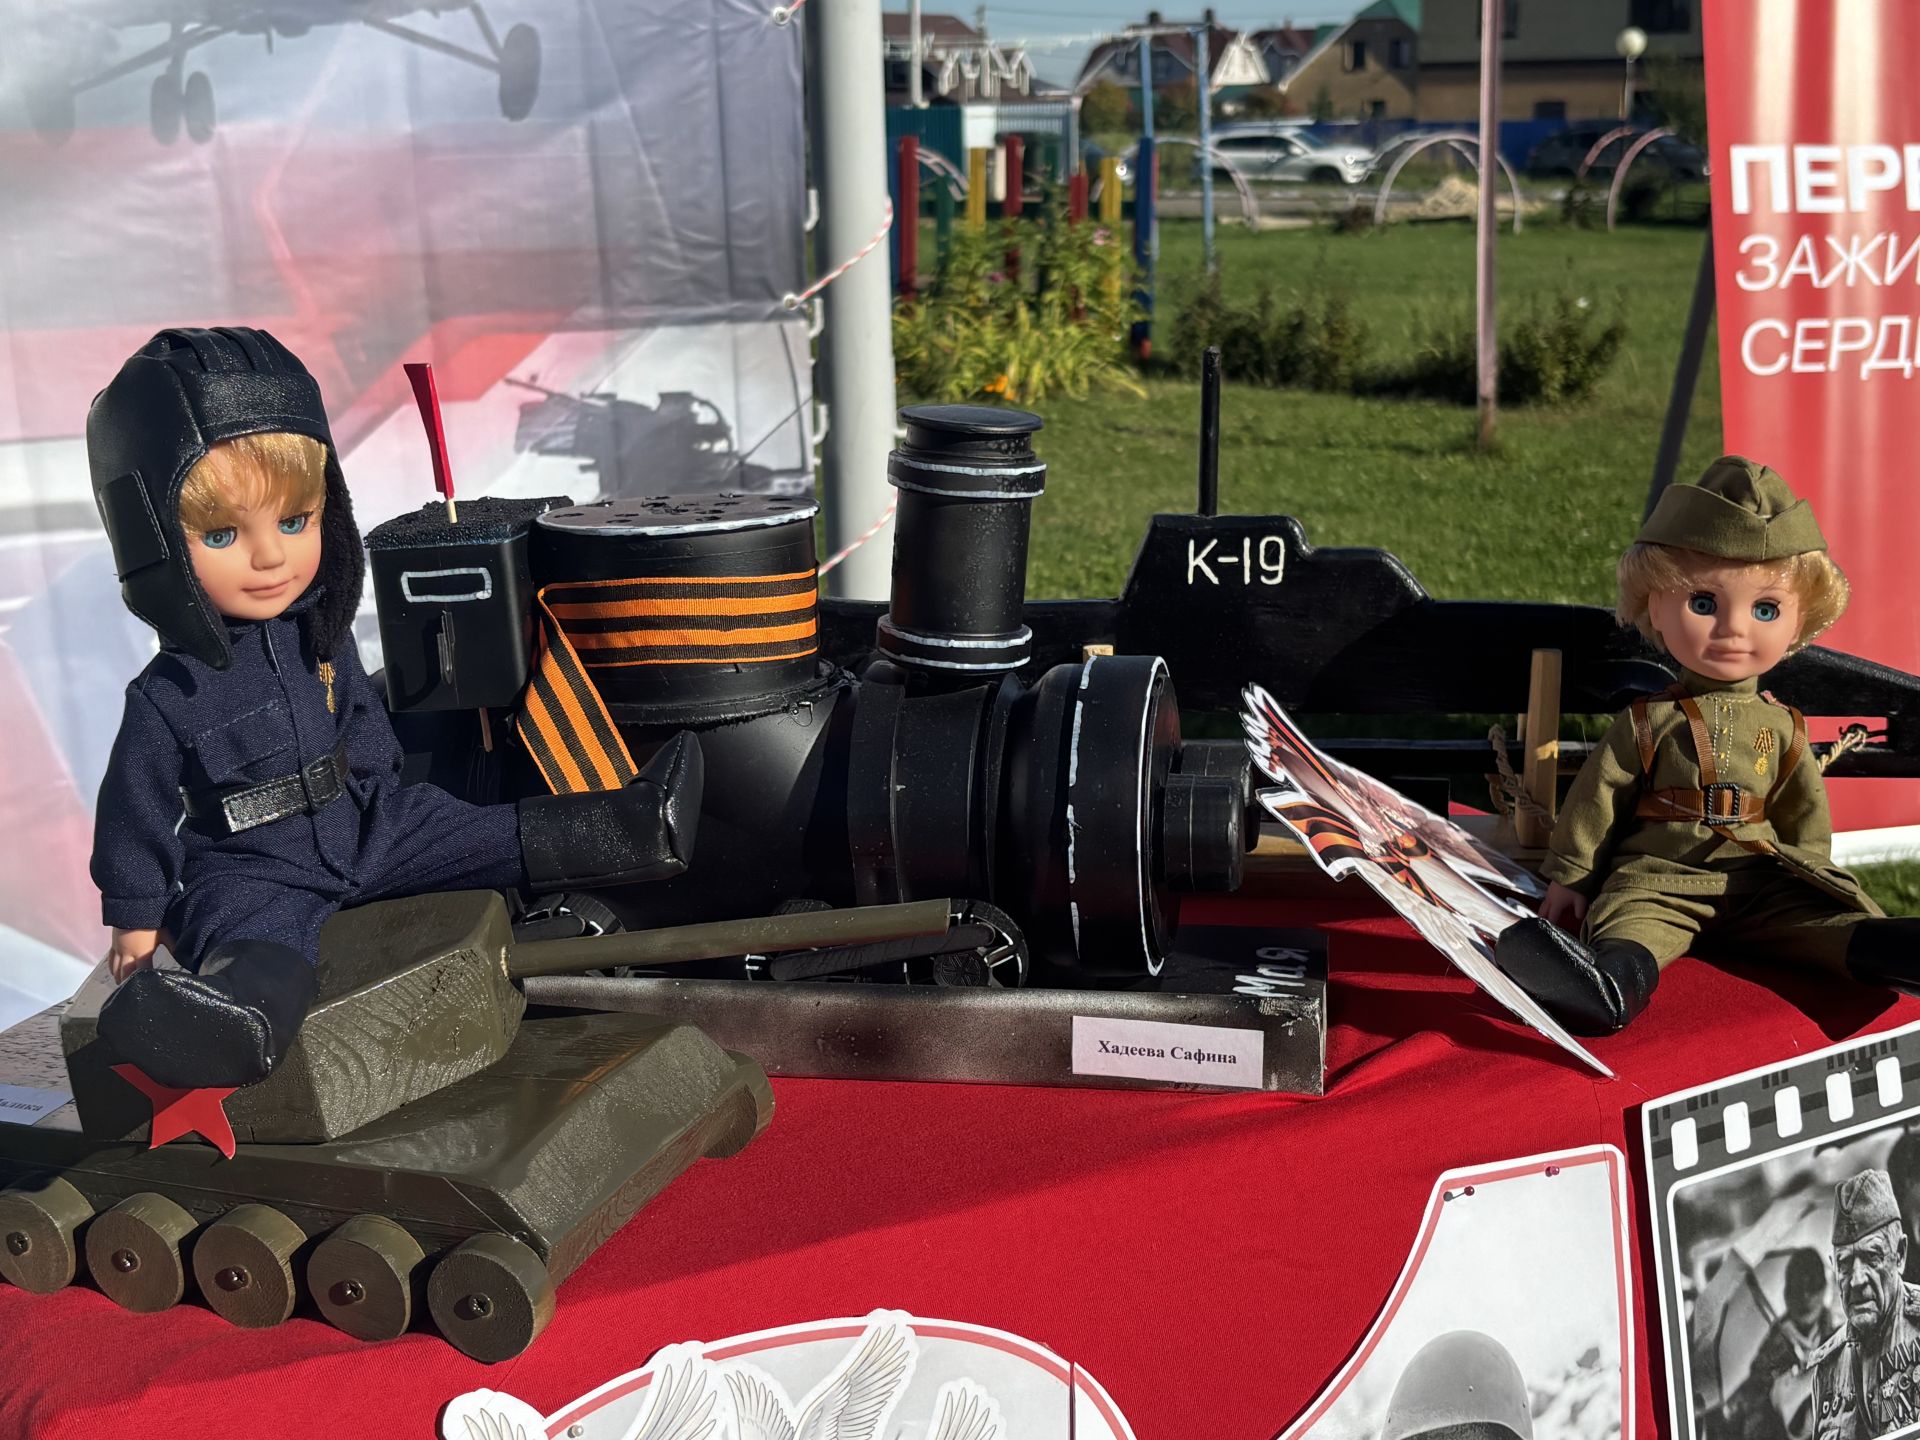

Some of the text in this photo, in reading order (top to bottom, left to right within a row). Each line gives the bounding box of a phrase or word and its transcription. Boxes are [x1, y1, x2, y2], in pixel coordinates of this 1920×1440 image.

[1735, 232, 1920, 291] ЗАЖИ
[1741, 315, 1920, 381] СЕРД
[1187, 536, 1285, 585] К-19
[1097, 1039, 1237, 1065] Хадеева Сафина
[0, 1098, 44, 1111] алика
